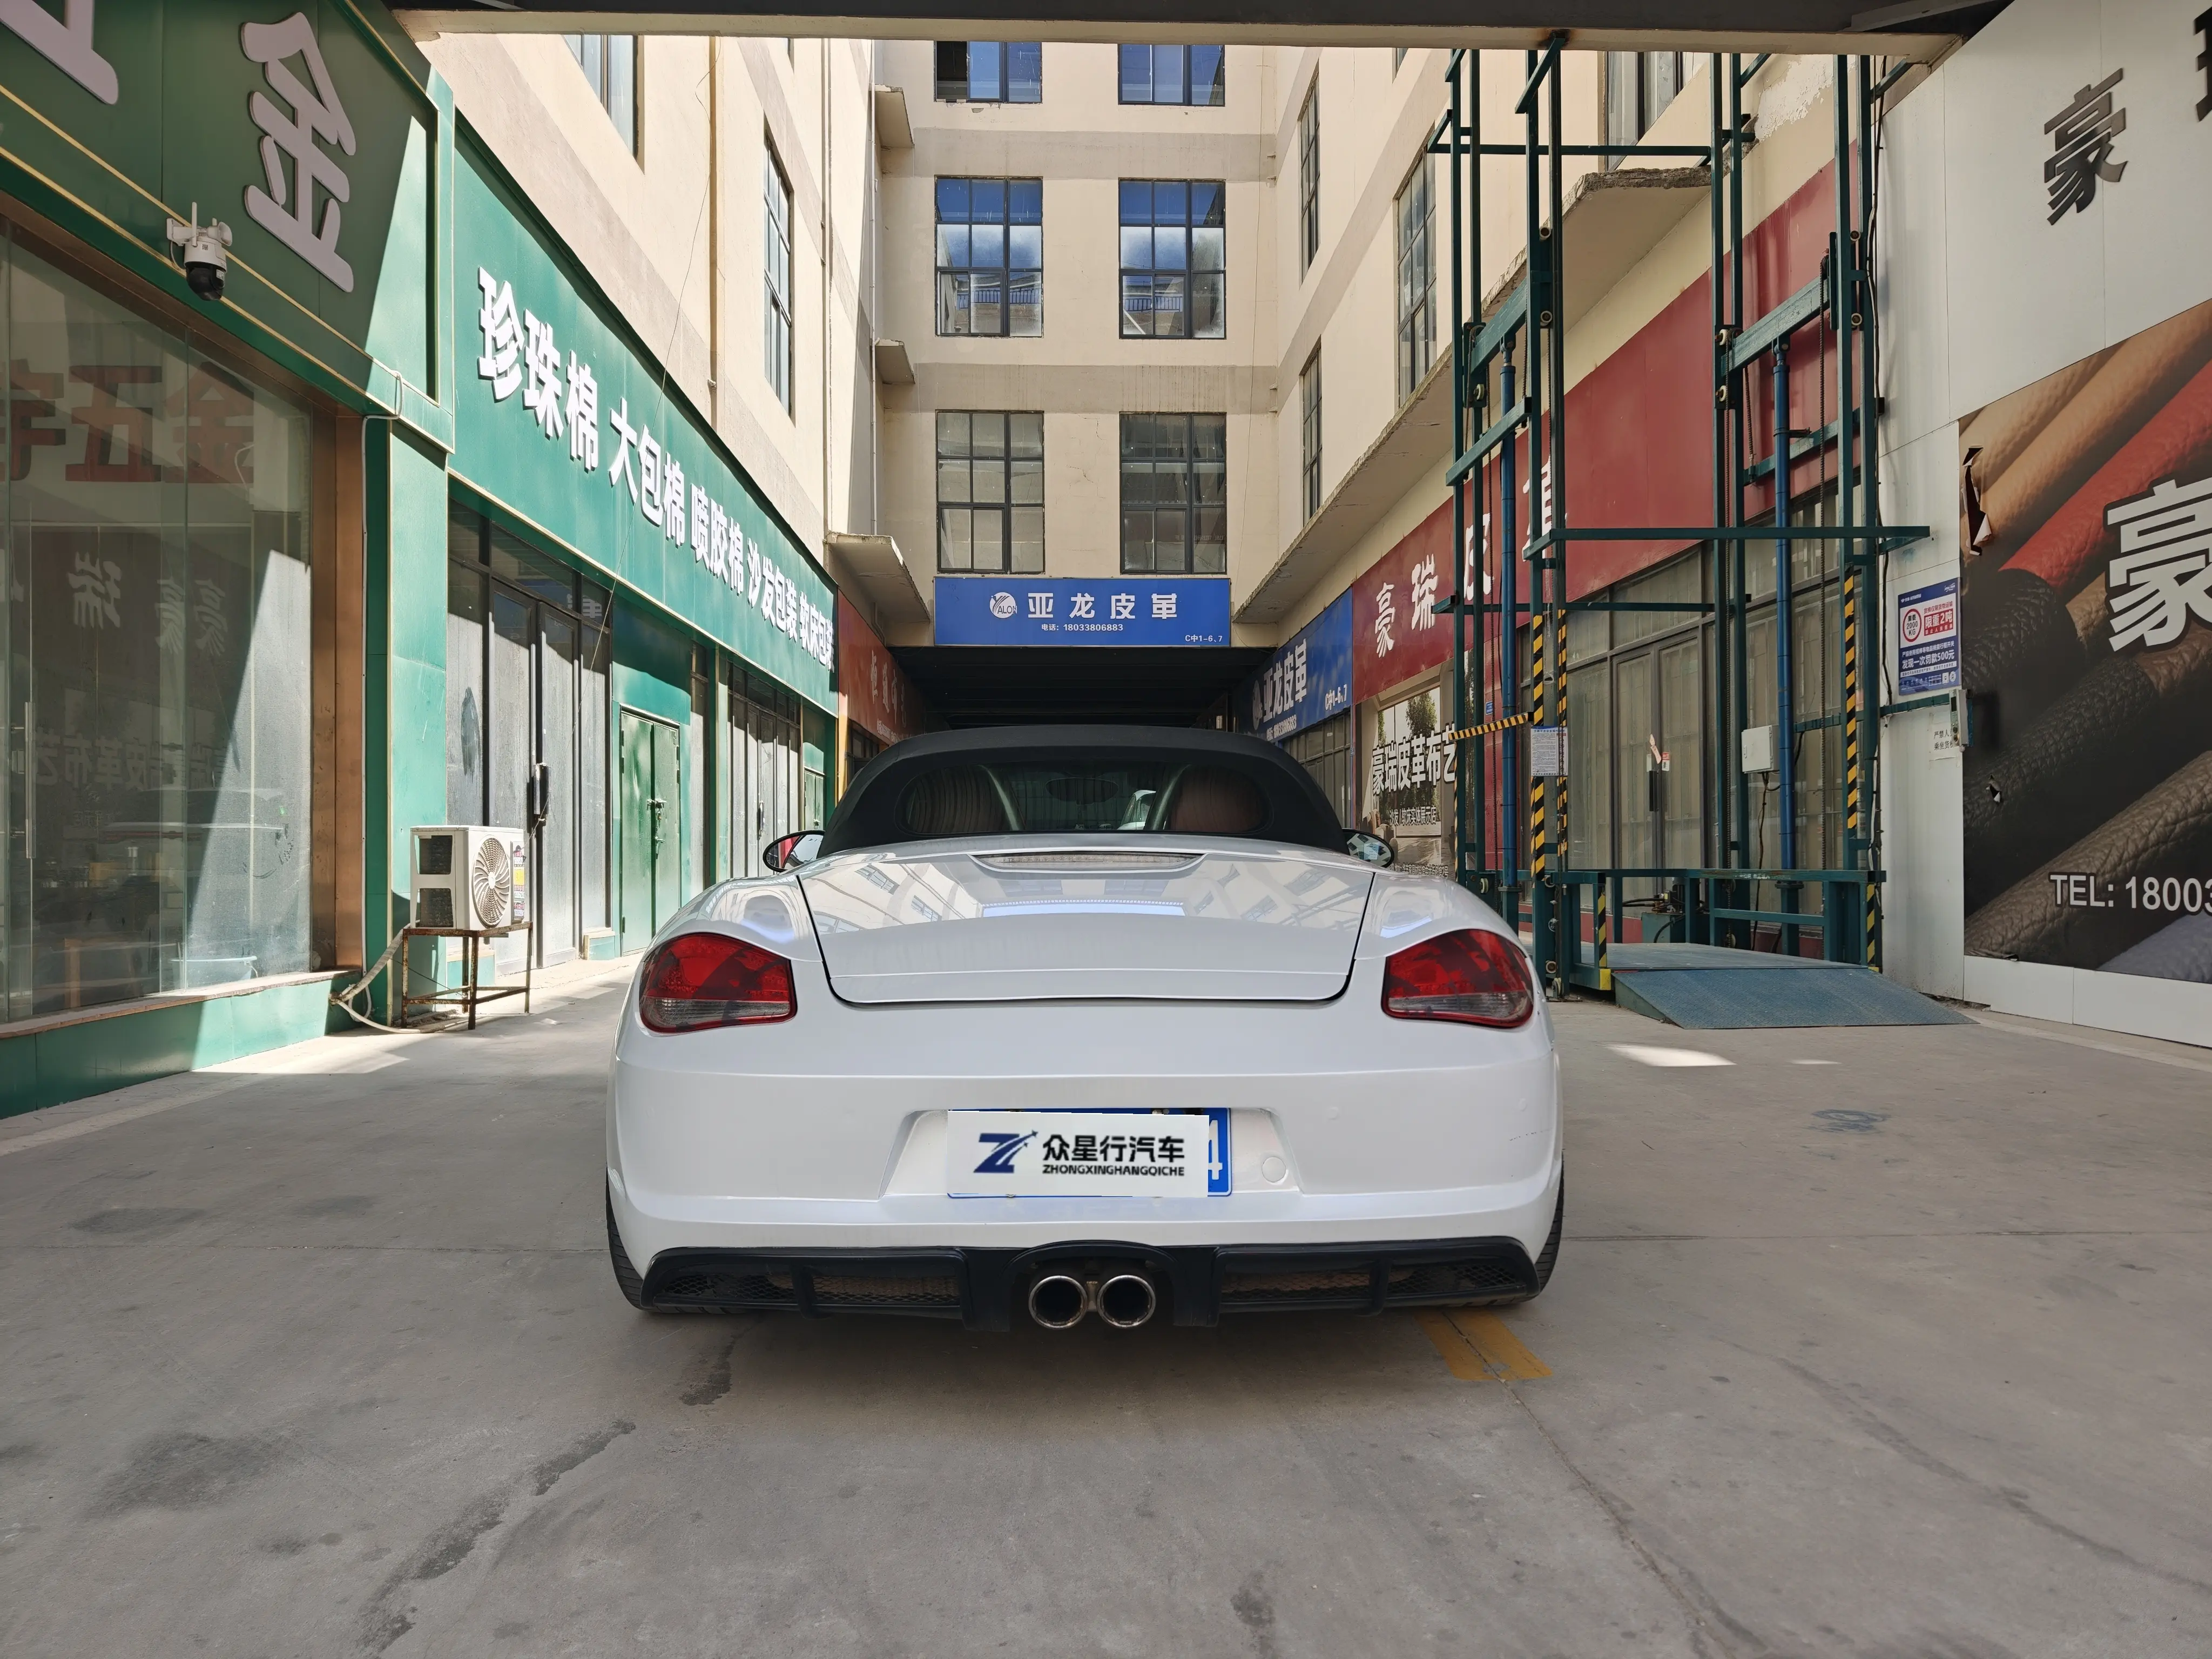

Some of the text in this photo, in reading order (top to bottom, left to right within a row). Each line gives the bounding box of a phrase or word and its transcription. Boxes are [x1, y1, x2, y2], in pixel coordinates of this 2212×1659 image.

[241, 11, 356, 292] 金
[2044, 68, 2128, 226] 豪
[478, 266, 834, 672] 珍珠棉 大包棉 喷胶棉 沙发包装 软床包装
[1028, 592, 1177, 619] 亚龙皮革
[1925, 610, 1953, 629] 限重2吨
[1906, 621, 1918, 630] 2000
[1908, 628, 1916, 636] KG
[1901, 650, 1955, 669] 发现一次罚款500元
[1263, 638, 1306, 723] 亚龙皮革
[1934, 729, 1952, 739] 严禁人
[1373, 723, 1455, 794] 豪瑞皮革布艺
[2050, 875, 2114, 907] TEL:
